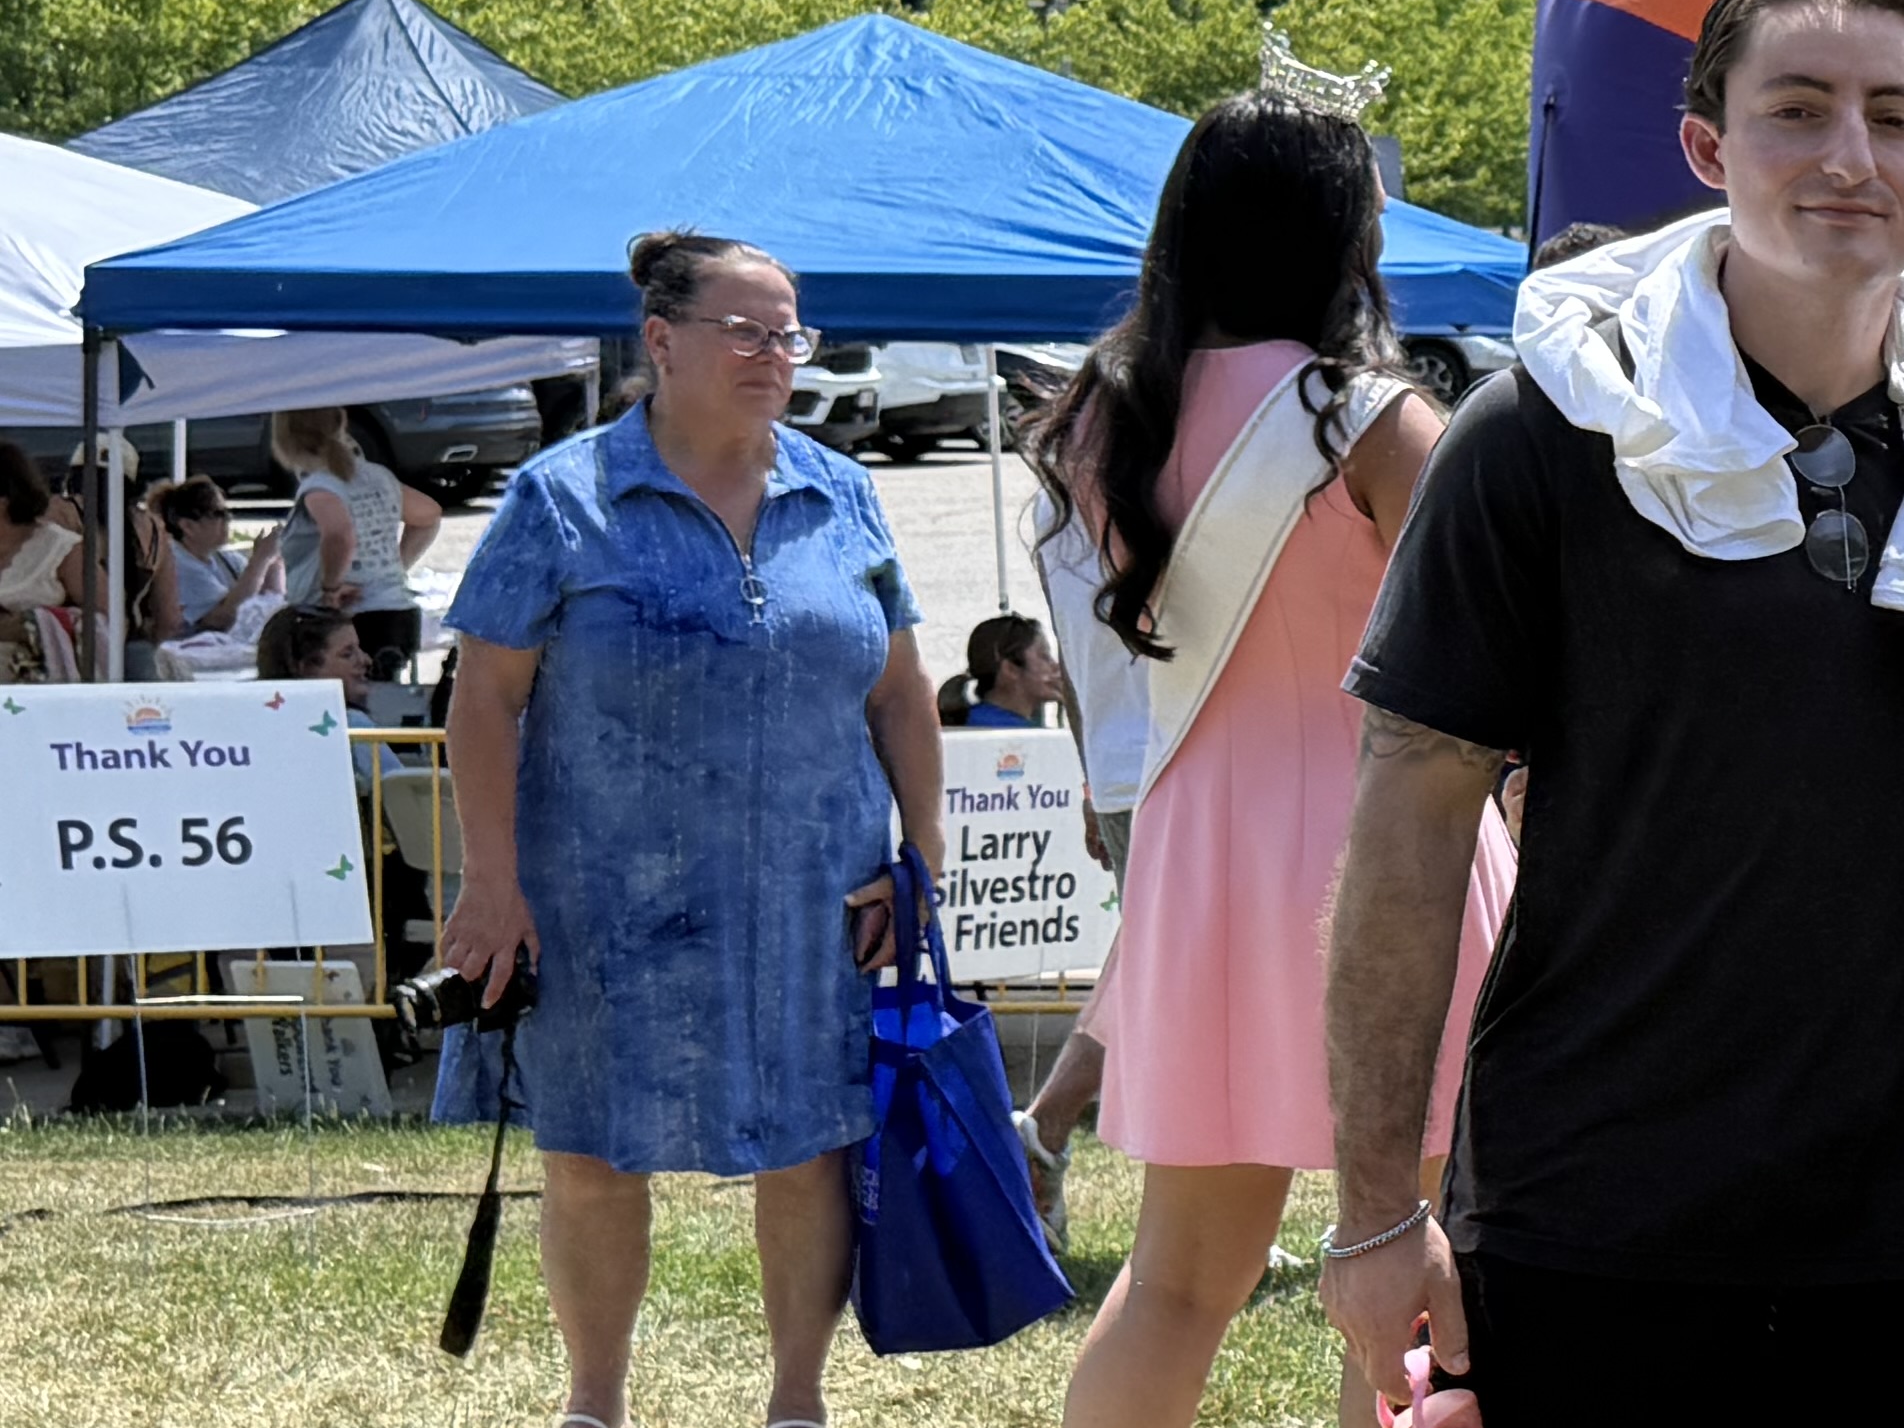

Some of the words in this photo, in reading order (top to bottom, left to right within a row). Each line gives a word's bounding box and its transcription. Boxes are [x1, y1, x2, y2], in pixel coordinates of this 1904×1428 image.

[50, 740, 173, 771] Thank
[179, 740, 251, 768] You
[946, 785, 1020, 814] Thank
[1027, 784, 1070, 809] You
[57, 818, 163, 870] P.S.
[181, 816, 253, 867] 56
[961, 825, 1052, 868] Larry
[954, 905, 1080, 952] Friends
